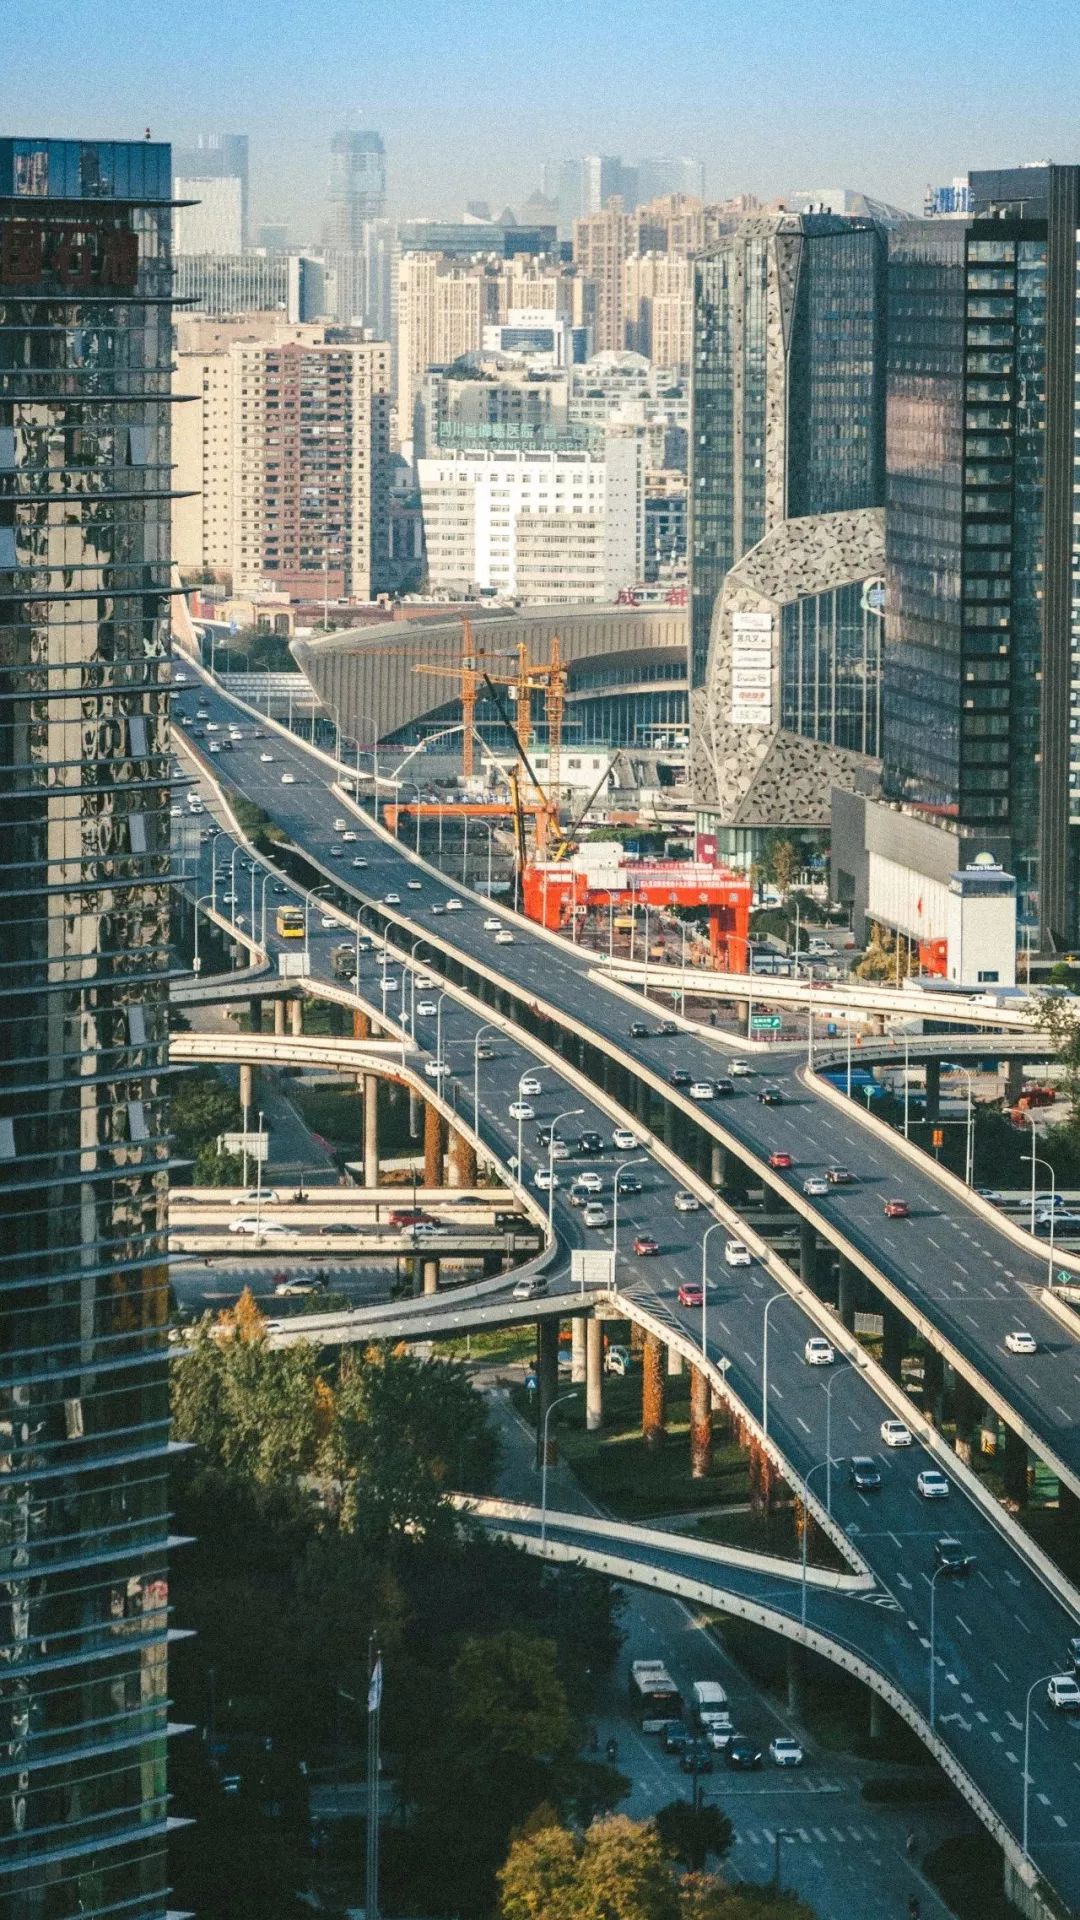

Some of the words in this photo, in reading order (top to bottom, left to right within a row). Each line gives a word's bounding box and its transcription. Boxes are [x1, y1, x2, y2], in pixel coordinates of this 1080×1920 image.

[440, 440, 485, 449] SICHUAN
[490, 441, 536, 450] CANCER
[614, 584, 688, 606] 成都
[966, 864, 984, 872] Days
